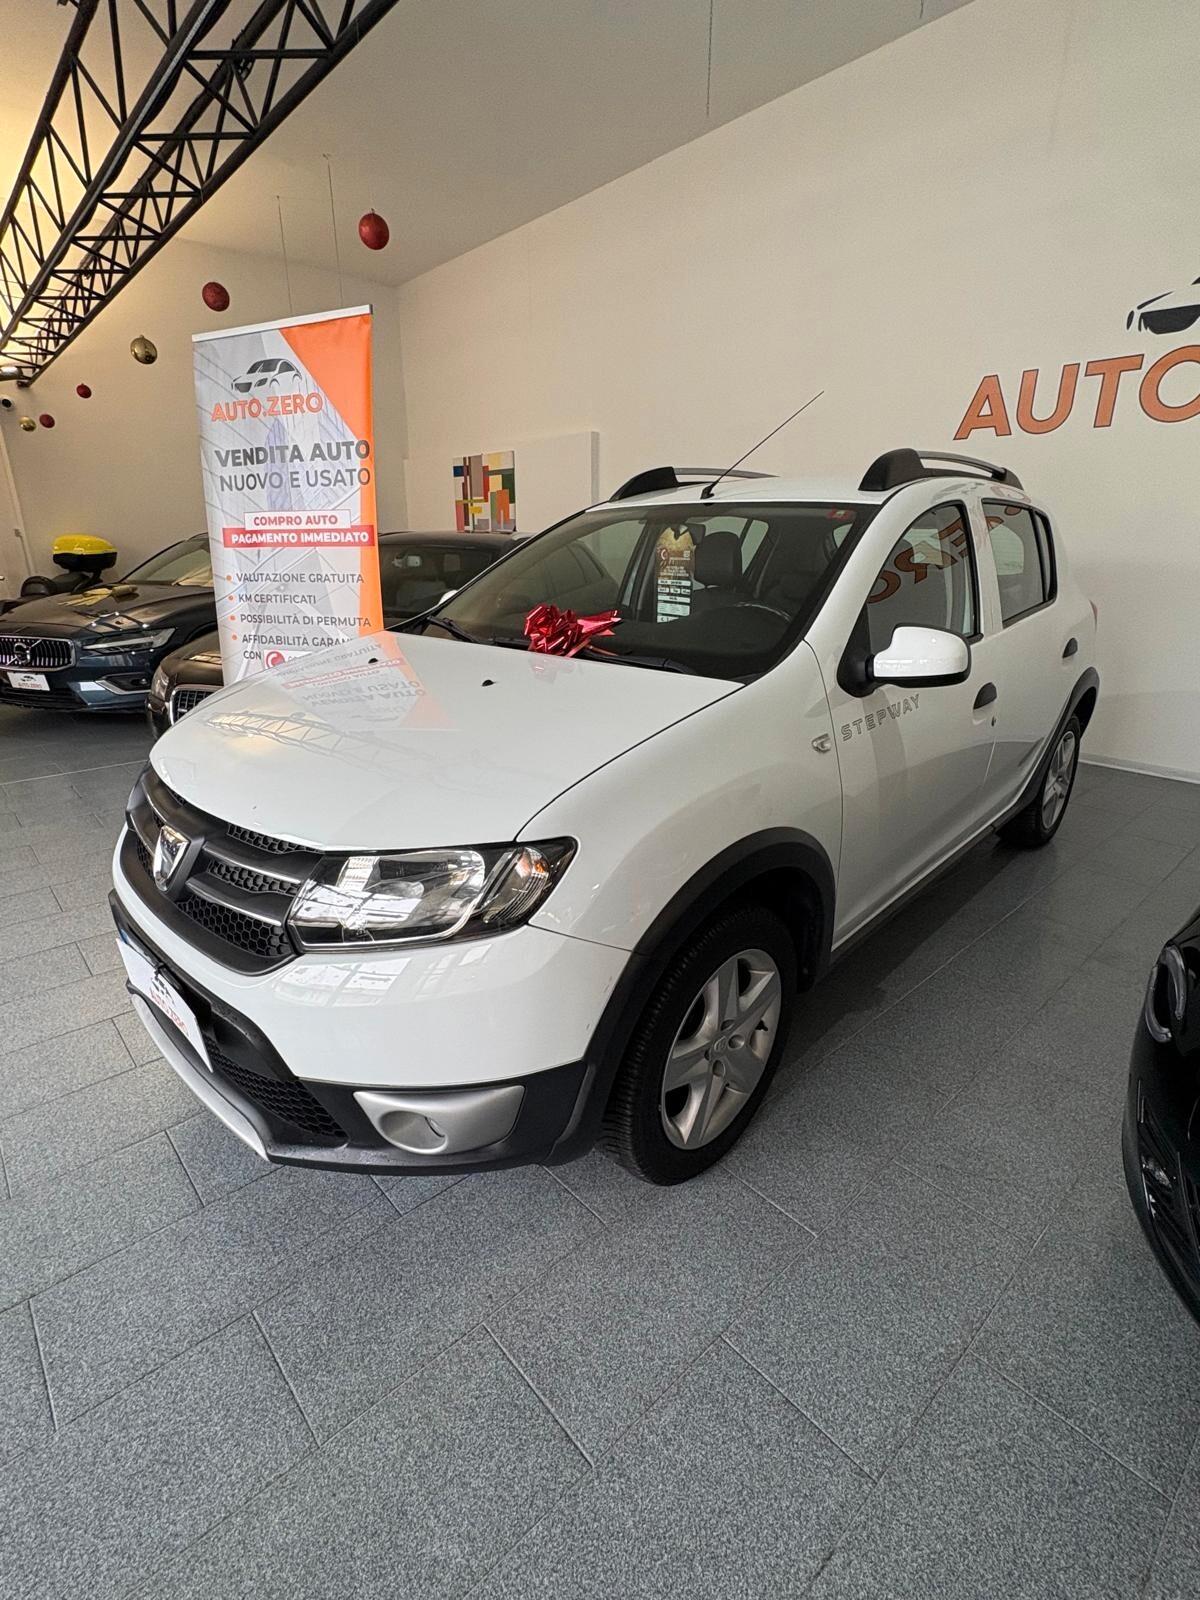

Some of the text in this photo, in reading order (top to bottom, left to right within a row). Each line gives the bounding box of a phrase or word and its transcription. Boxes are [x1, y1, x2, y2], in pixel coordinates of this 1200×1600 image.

[953, 344, 1200, 440] AUTO
[211, 392, 323, 422] AUTO.ZERO
[215, 440, 370, 467] VENDITA AUTO
[220, 468, 371, 492] NUOVO E USATO
[253, 515, 338, 527] COMPRO AUTO
[231, 531, 369, 544] PAGAMENTO IMMEDIATO
[236, 573, 364, 584] VALUTAZIONE GRATUITA
[238, 593, 316, 604] KM CERTIFICATI
[240, 613, 371, 627] POSSIBILITÀ DI PERMUTA
[242, 633, 309, 647] AFFIDABILITÀ
[243, 650, 262, 660] CON
[840, 693, 921, 742] STEPWAY
